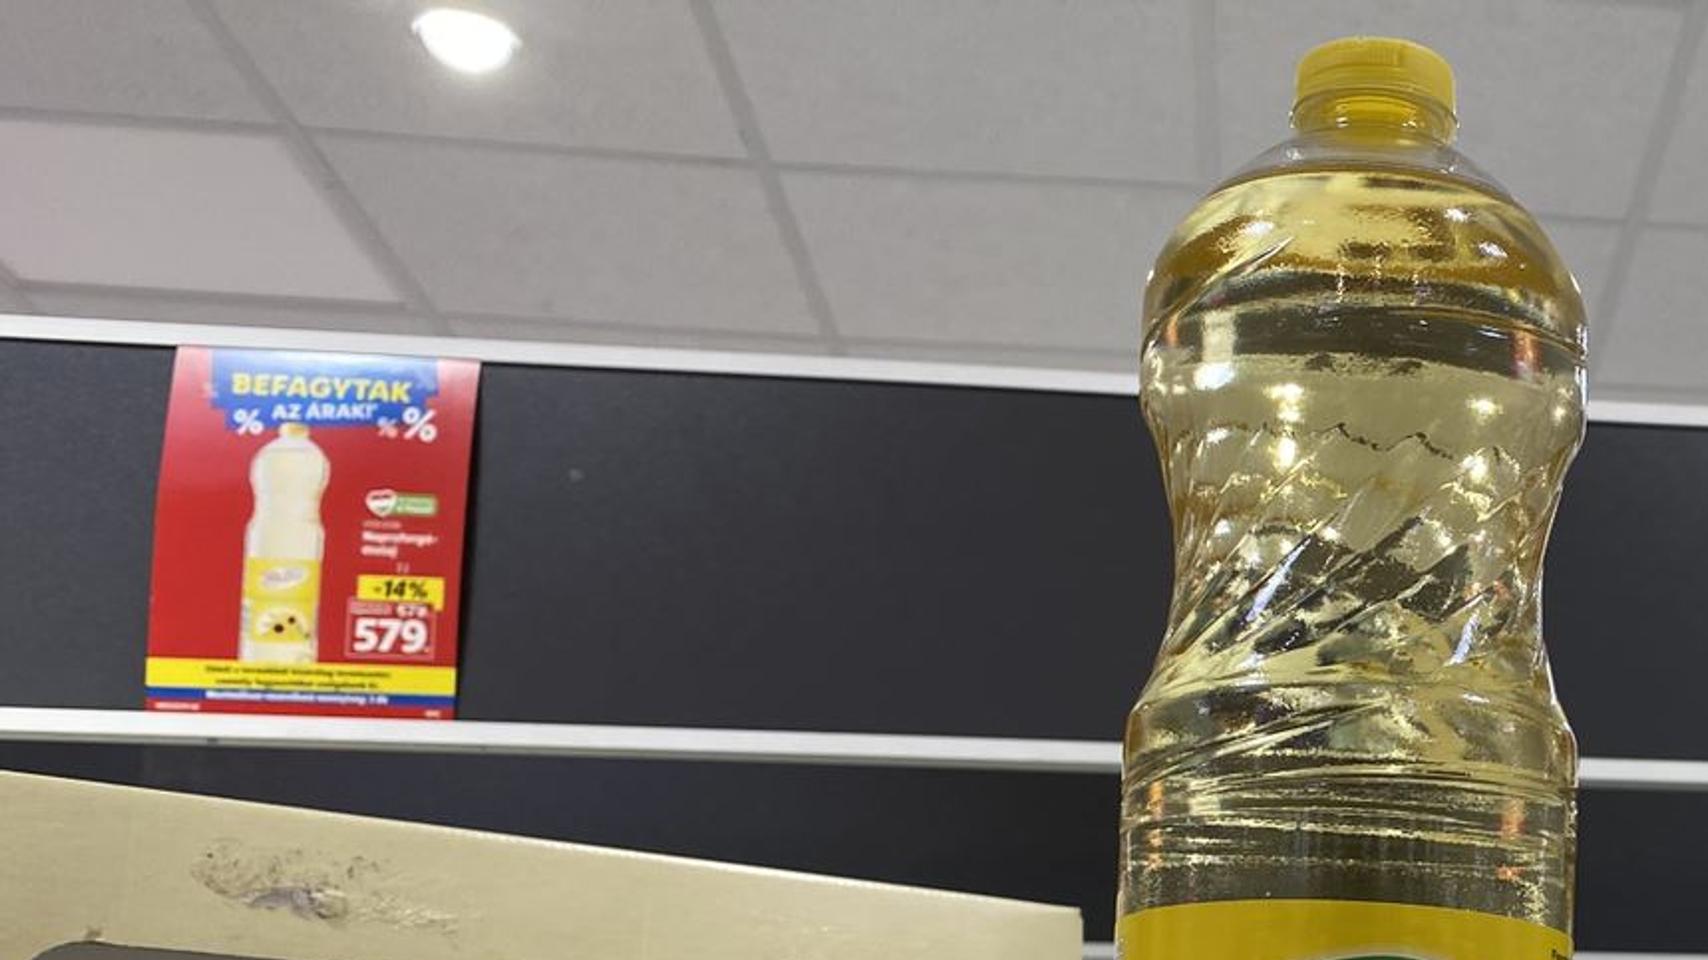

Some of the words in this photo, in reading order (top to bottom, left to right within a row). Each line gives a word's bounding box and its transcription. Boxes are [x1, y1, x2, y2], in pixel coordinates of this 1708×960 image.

[231, 372, 412, 403] BEFAGYTAK
[272, 404, 302, 420] AZ
[353, 617, 428, 653] 579
